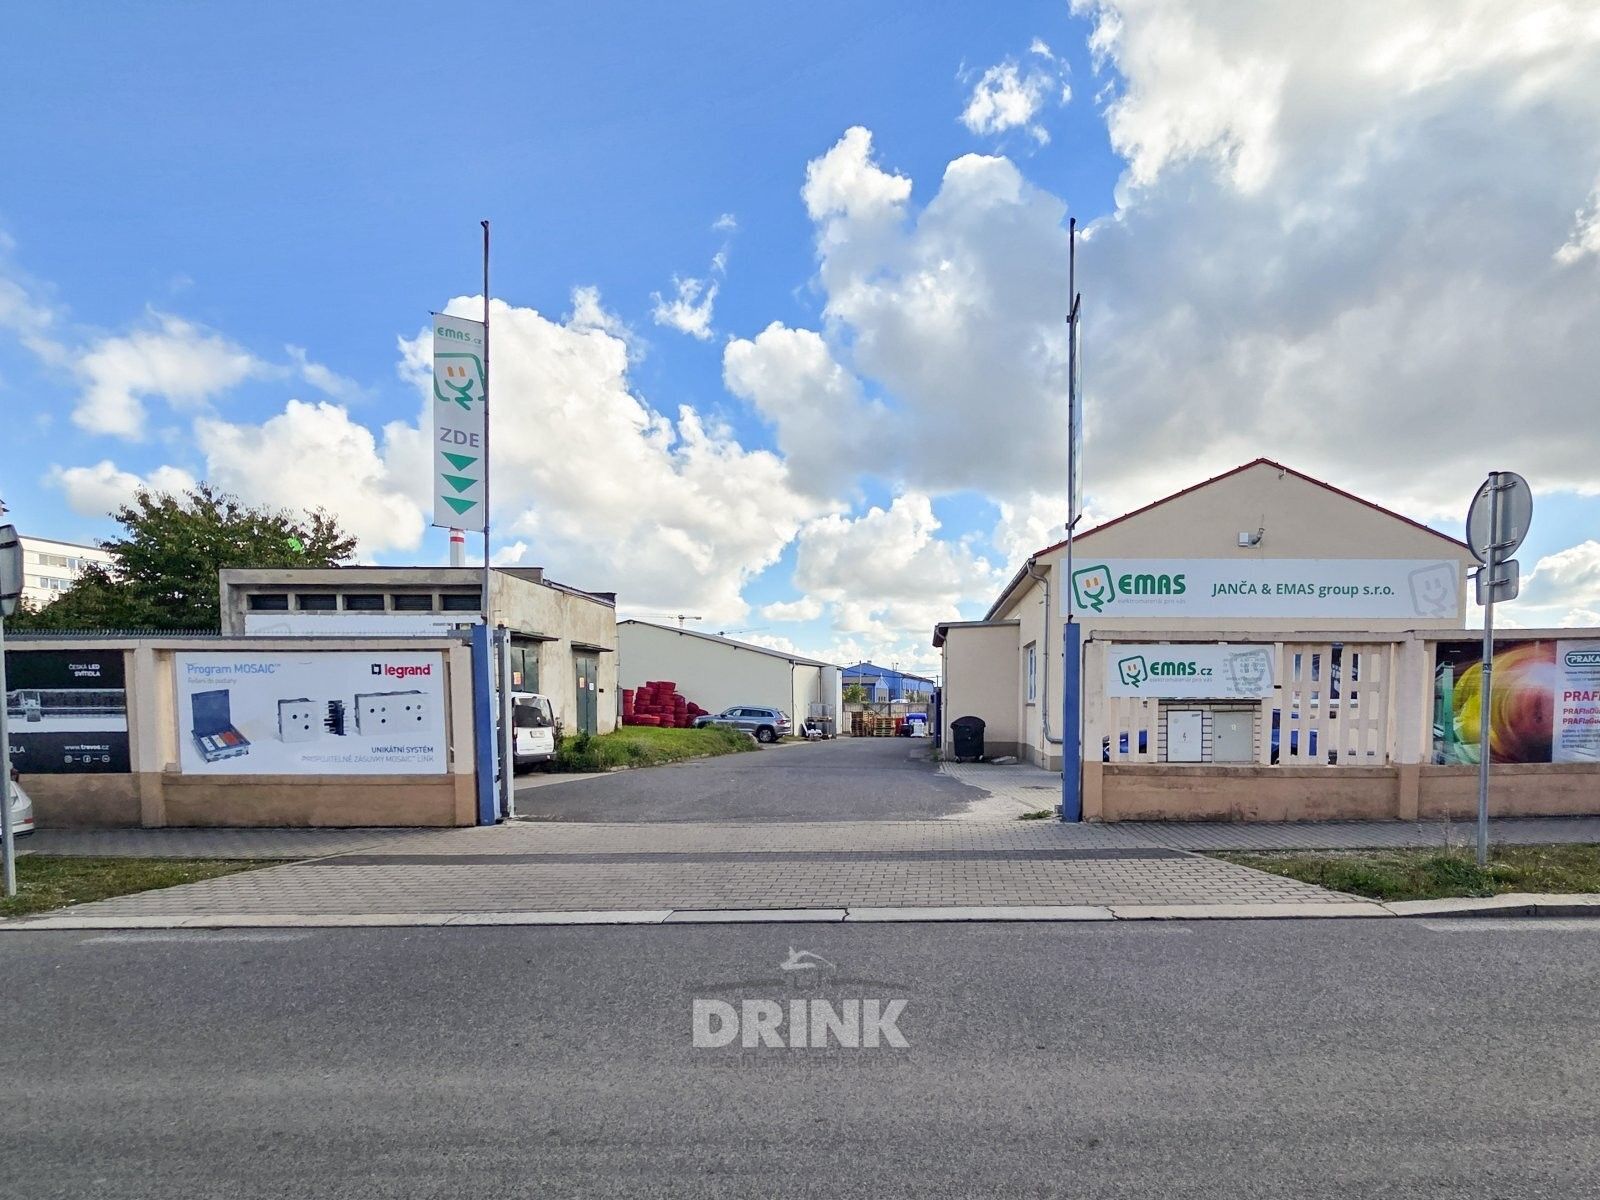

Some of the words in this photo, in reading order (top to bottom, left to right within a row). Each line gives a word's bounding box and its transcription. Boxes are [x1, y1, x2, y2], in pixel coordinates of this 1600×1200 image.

[437, 327, 482, 344] EMAS.cz
[440, 427, 479, 448] ZDE
[1118, 574, 1186, 595] EMAS
[1211, 581, 1257, 597] JANČA
[1261, 583, 1272, 595] &
[1276, 583, 1315, 595] EMAS
[1318, 585, 1359, 598] group
[1363, 585, 1395, 595] s.r.o.
[187, 664, 232, 677] Program
[384, 664, 432, 679] legrand
[1150, 662, 1213, 676] EMAS.cz
[371, 745, 405, 754] UNIKÁTNÍ
[406, 745, 434, 754] SYSTÉM
